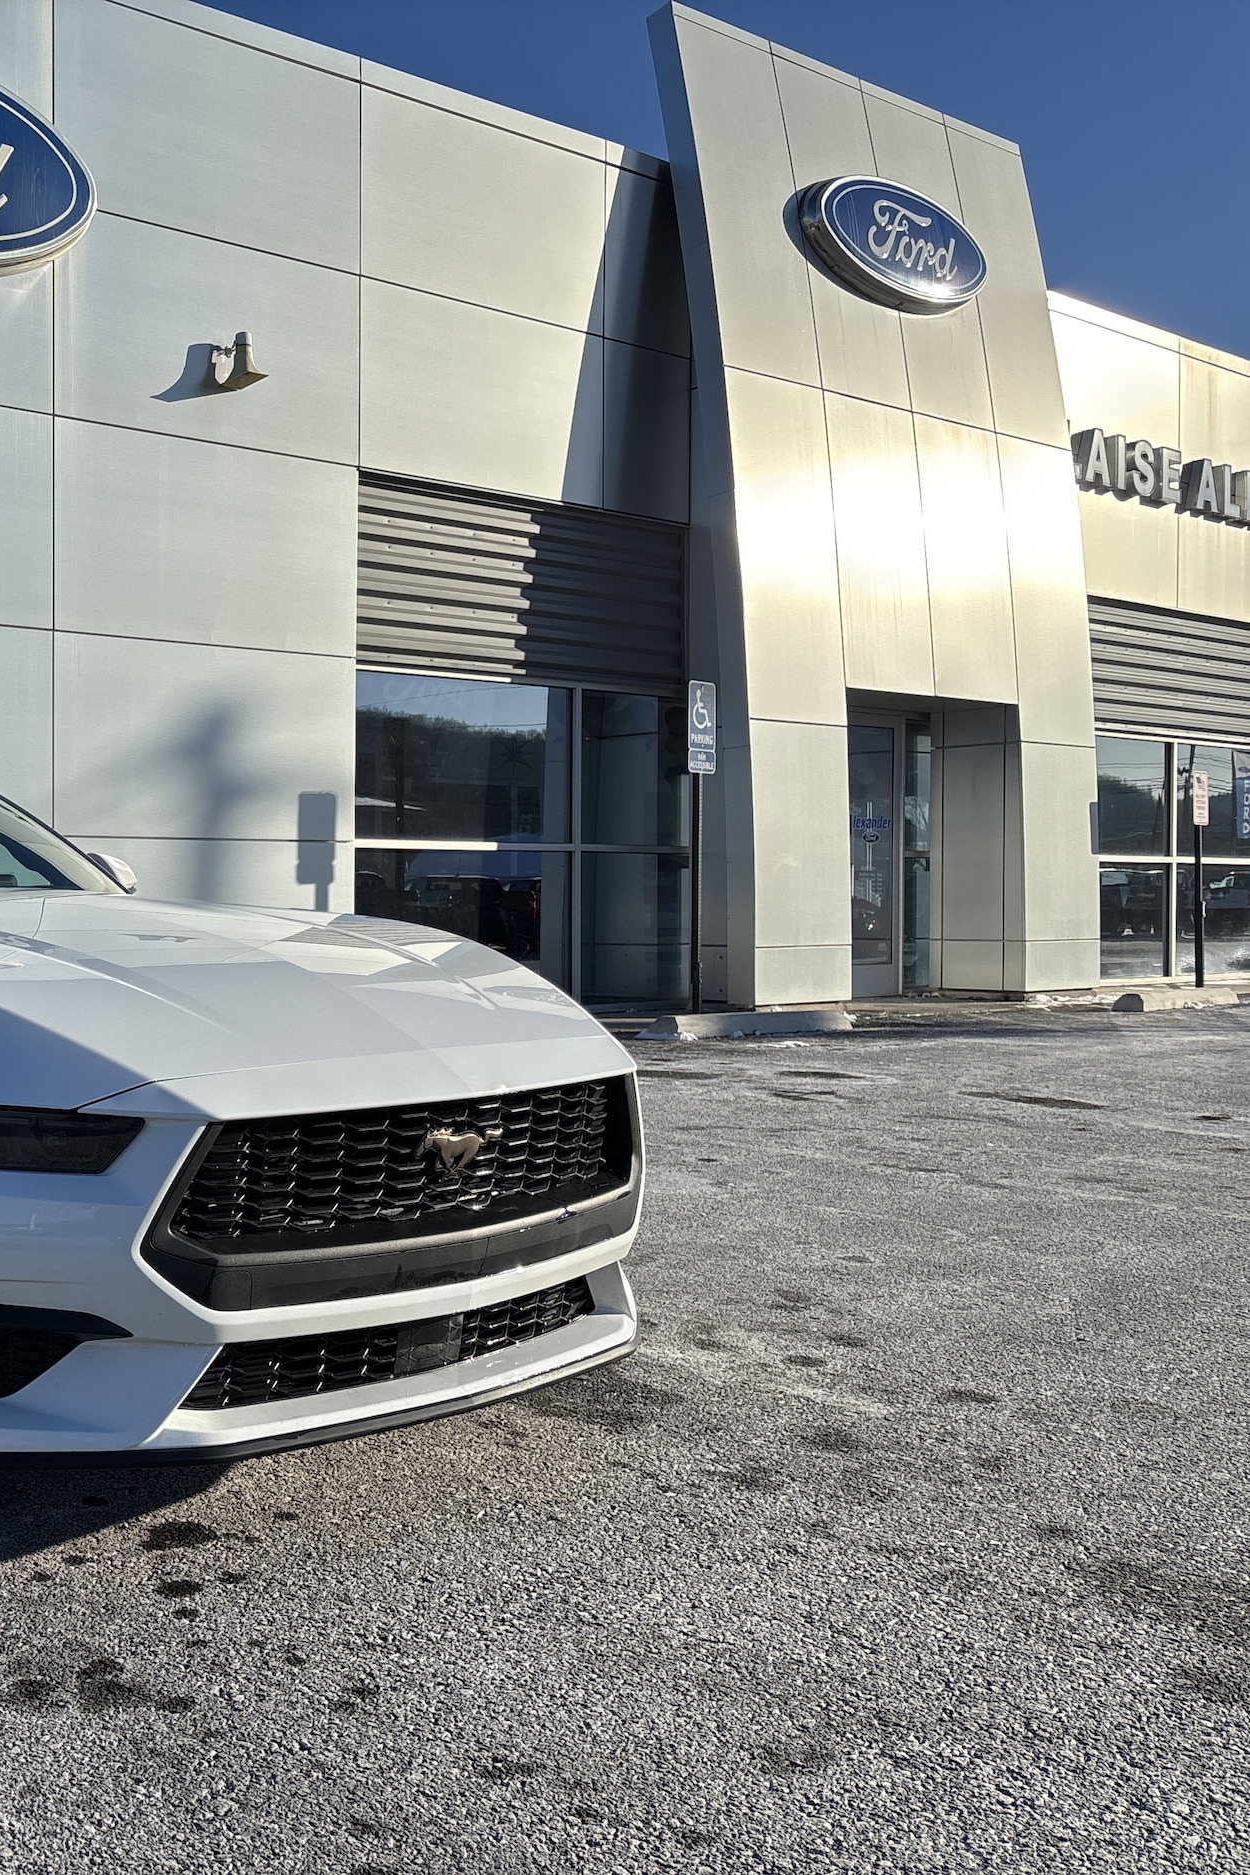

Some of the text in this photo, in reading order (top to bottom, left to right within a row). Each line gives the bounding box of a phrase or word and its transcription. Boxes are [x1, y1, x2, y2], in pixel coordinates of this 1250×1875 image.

[868, 200, 958, 280] Ford
[691, 733, 713, 745] PARKING
[697, 752, 707, 761] VAN
[690, 760, 714, 770] ACCESSIBLE
[850, 815, 891, 831] lexander
